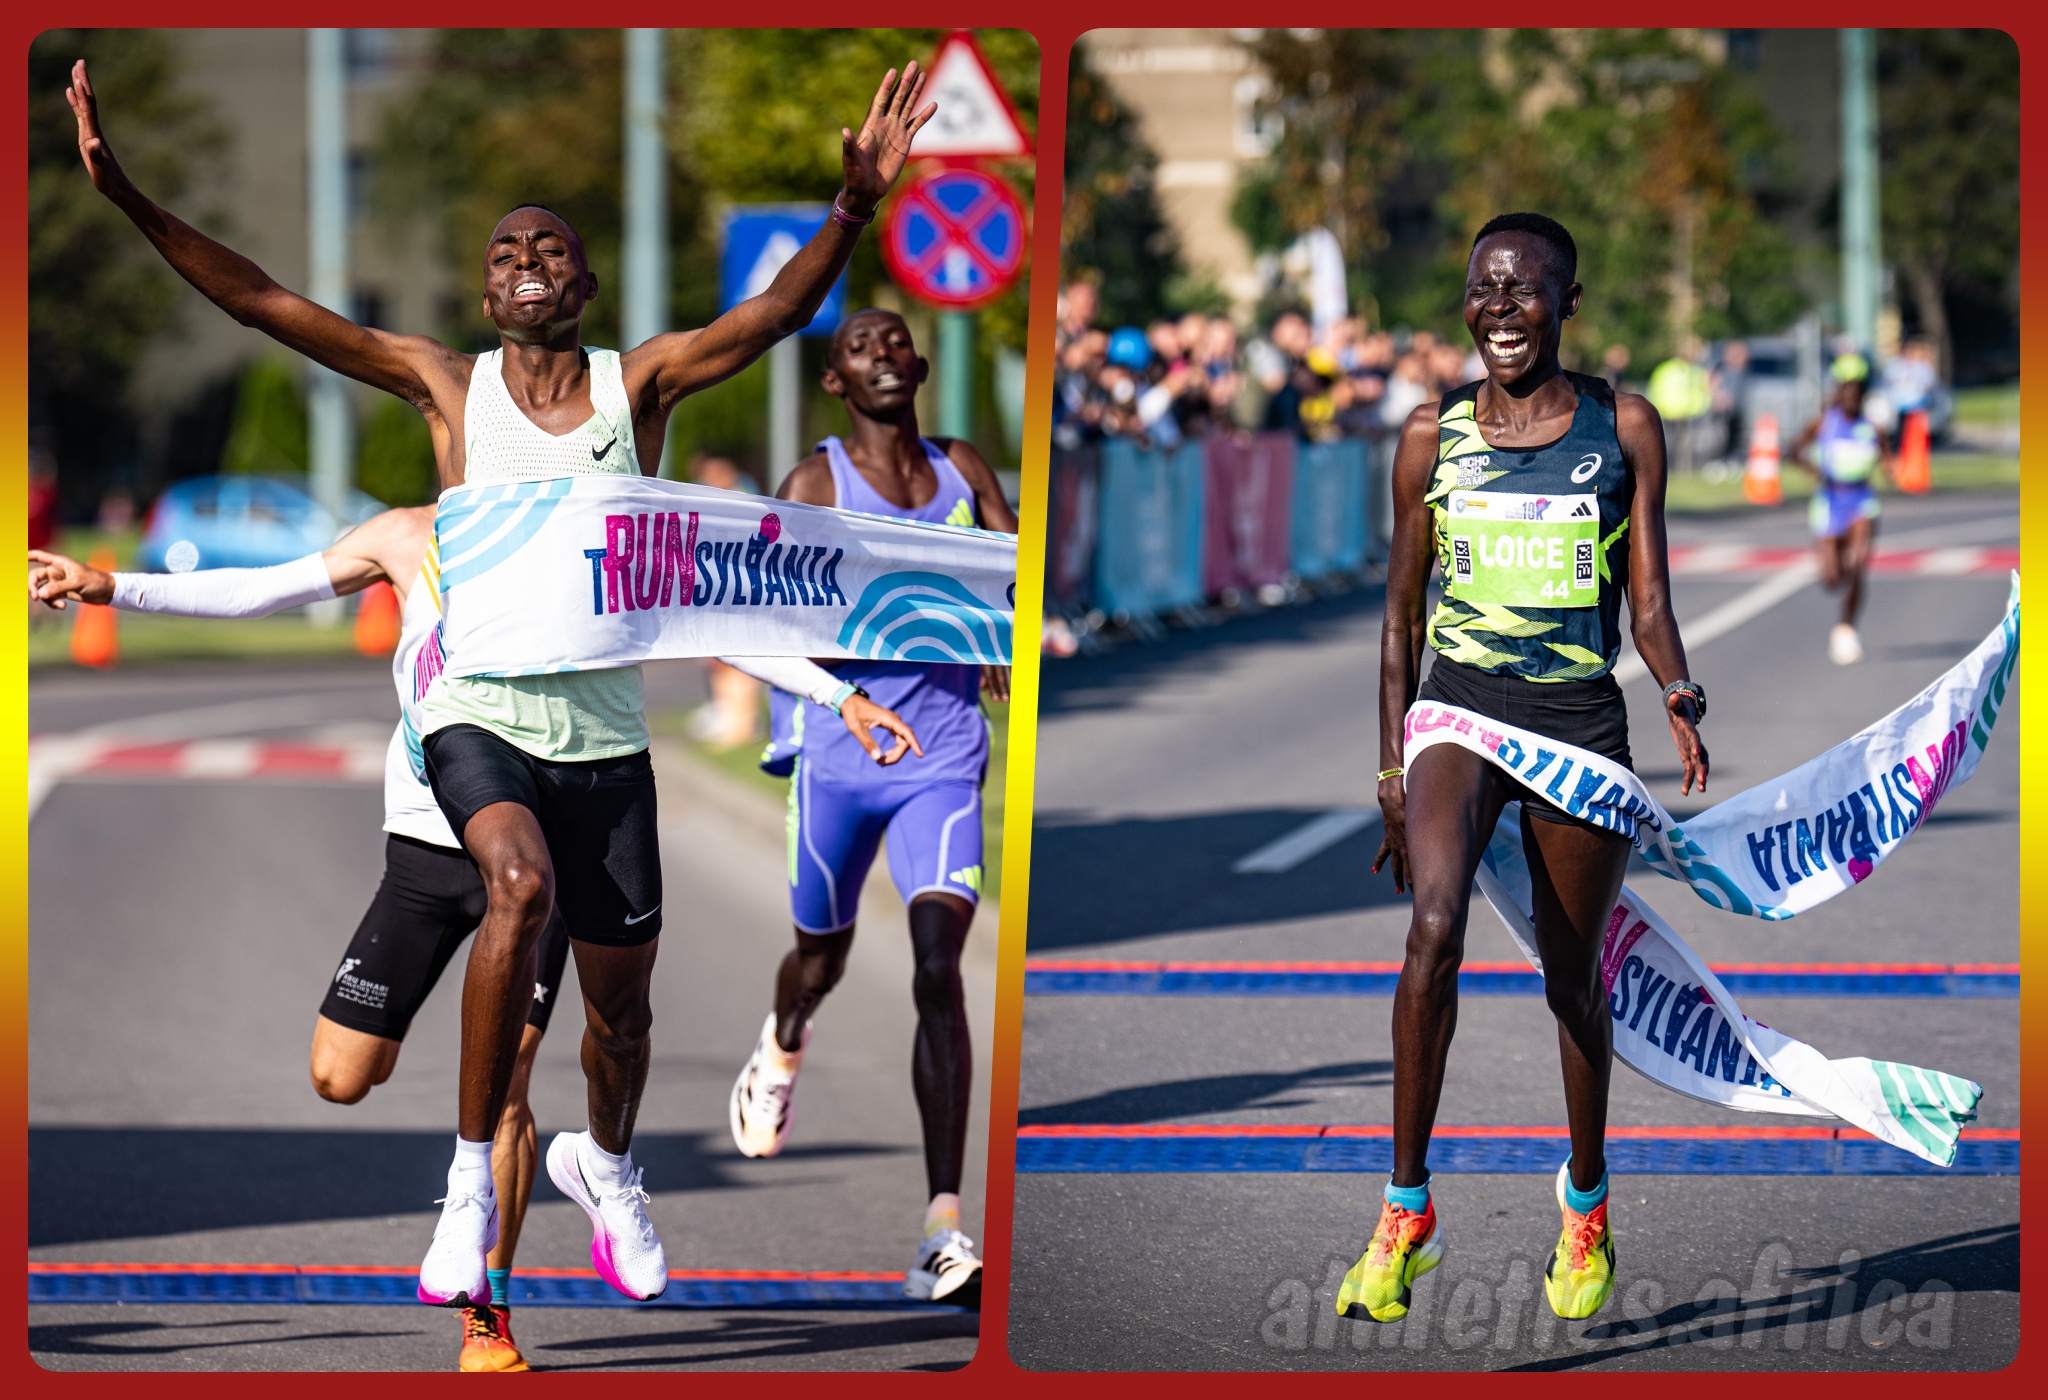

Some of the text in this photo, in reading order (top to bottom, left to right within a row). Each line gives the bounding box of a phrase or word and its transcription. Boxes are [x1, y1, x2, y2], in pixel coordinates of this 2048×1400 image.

[1457, 475, 1489, 487] CAMP
[1479, 533, 1565, 570] LOICE
[1540, 580, 1570, 600] 44
